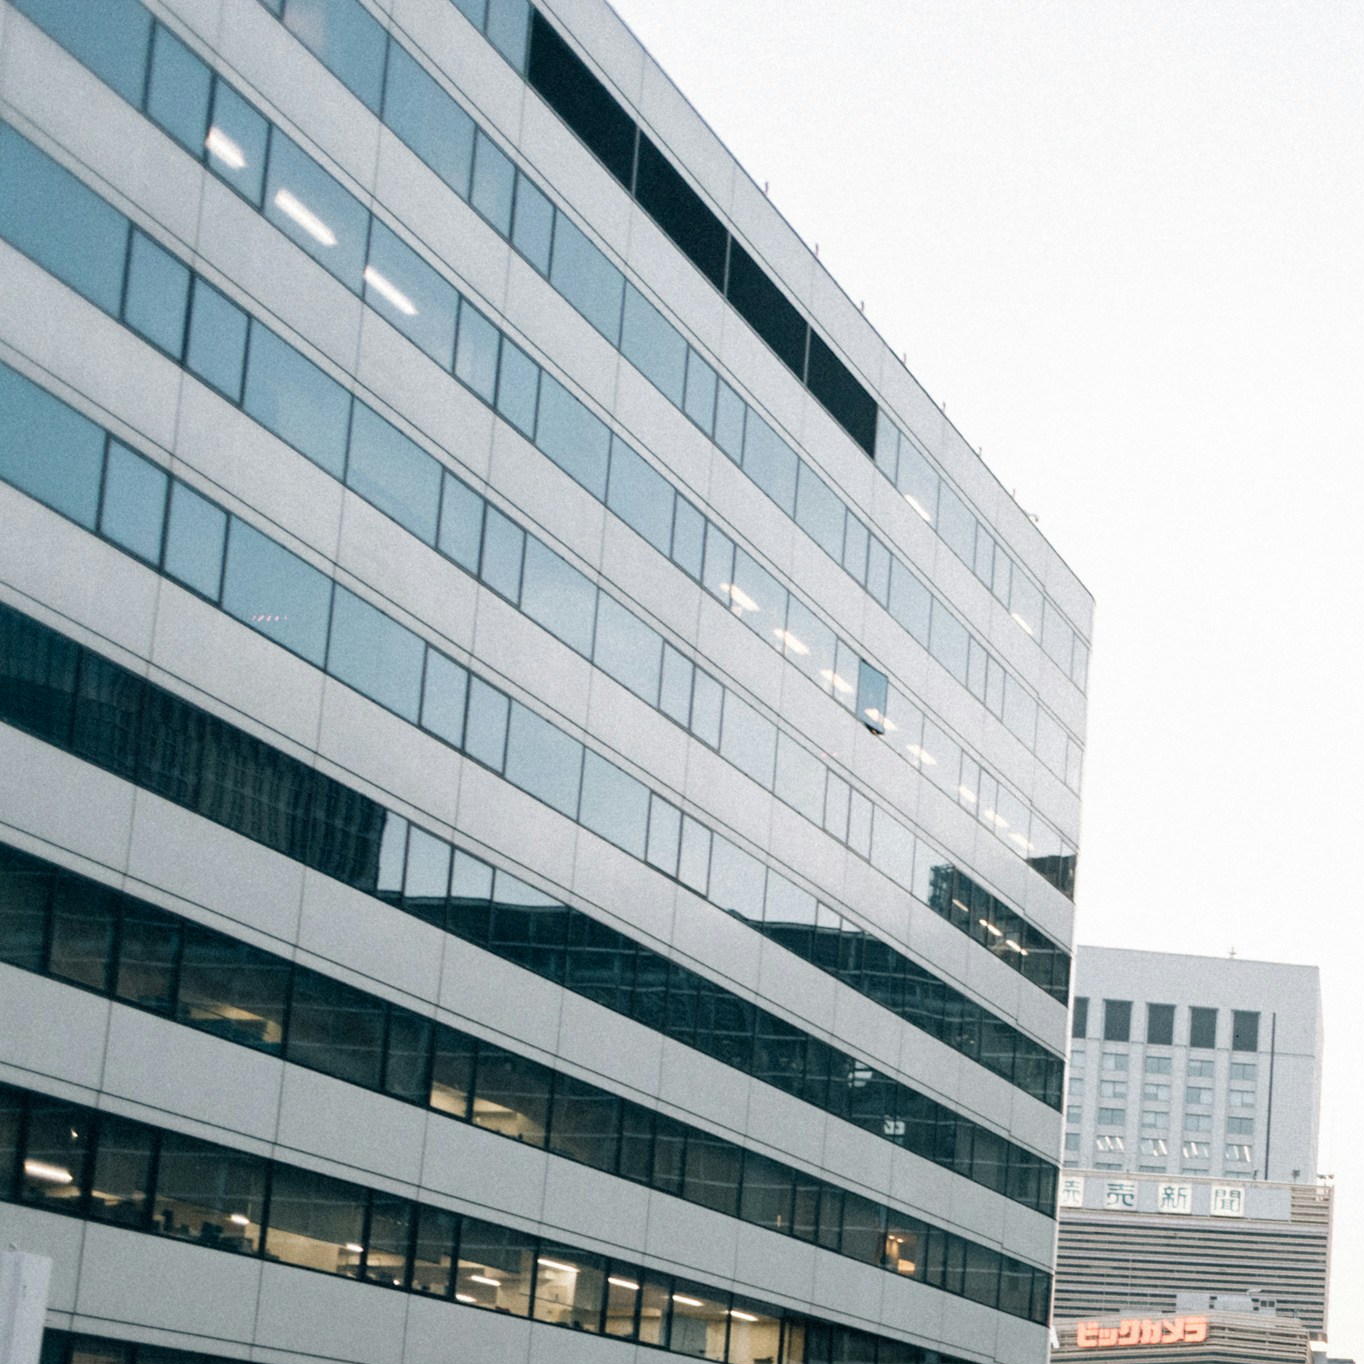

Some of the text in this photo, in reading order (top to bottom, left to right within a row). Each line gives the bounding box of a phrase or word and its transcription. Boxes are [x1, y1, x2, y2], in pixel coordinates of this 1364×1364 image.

[1076, 1315, 1208, 1348] ビックカメラ
